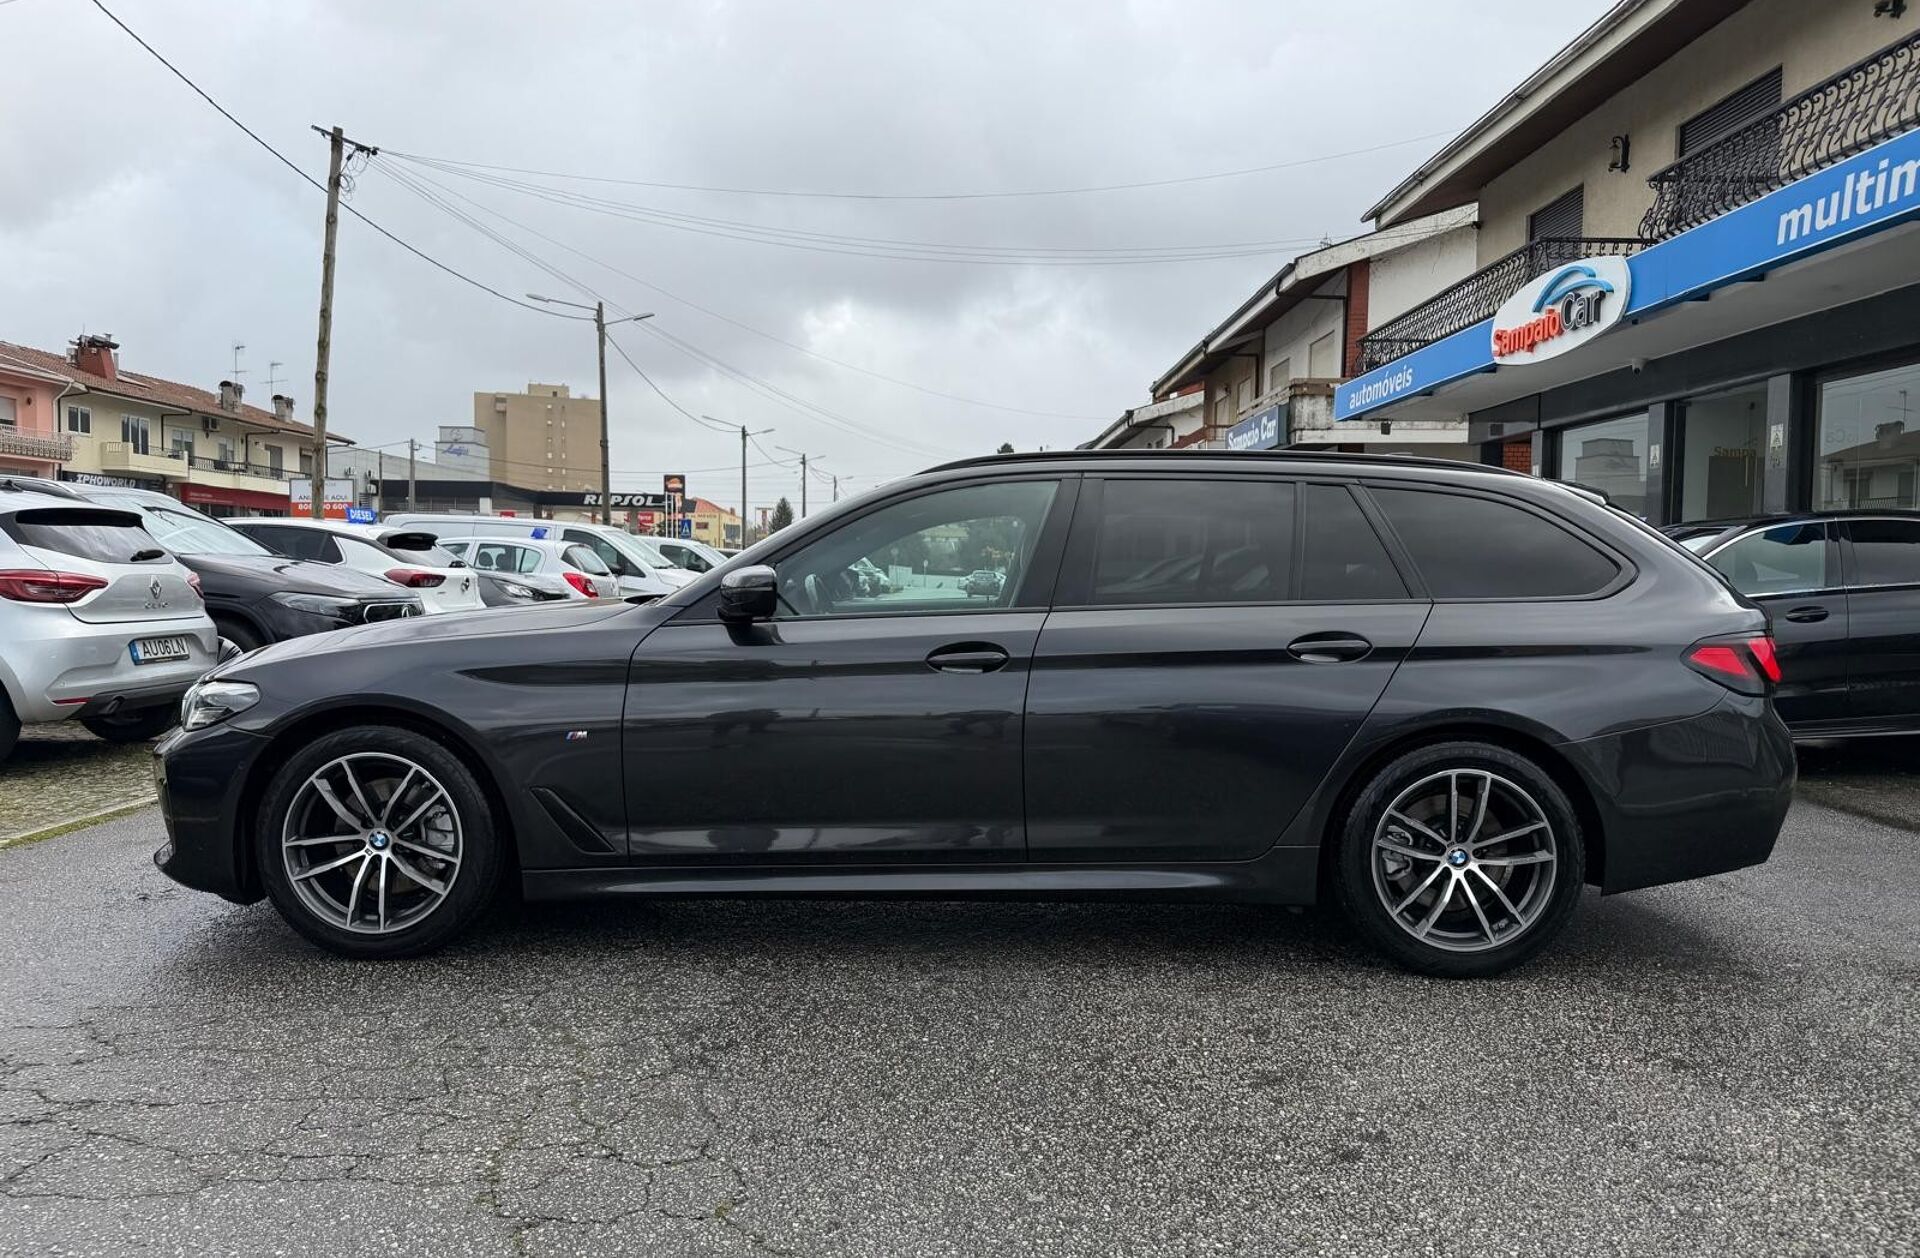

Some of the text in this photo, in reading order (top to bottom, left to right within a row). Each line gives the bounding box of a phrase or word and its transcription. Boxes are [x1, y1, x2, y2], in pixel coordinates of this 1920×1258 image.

[1350, 364, 1412, 410] automóveis
[1260, 415, 1277, 441] Car
[583, 494, 655, 506] RPSOL
[350, 508, 373, 521] DIESEL
